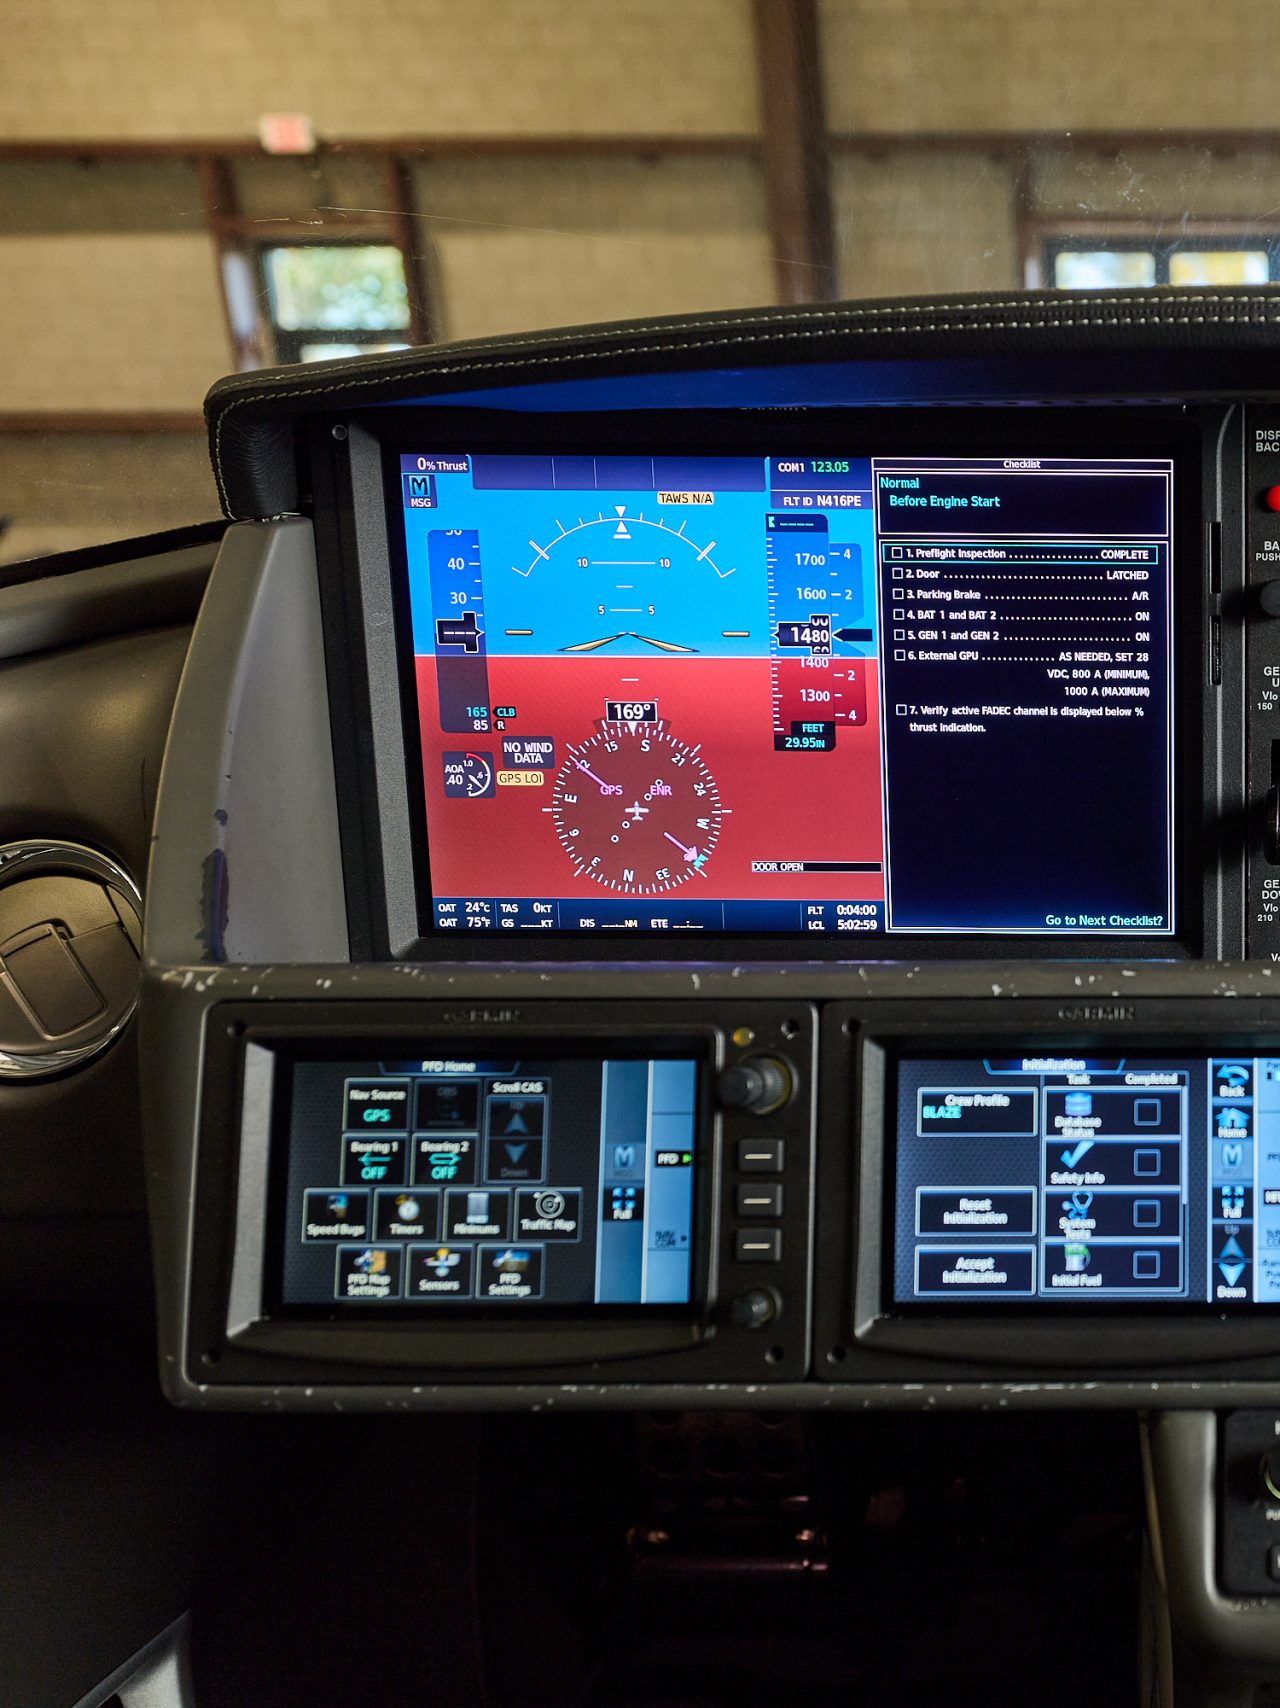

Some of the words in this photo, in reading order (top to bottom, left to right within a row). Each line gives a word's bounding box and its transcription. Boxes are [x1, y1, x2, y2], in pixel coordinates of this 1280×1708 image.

[778, 463, 805, 472] COM1
[811, 462, 849, 473] 123.05
[1004, 460, 1040, 468] Checklist
[880, 478, 919, 488] Normal
[411, 498, 431, 507] MSG
[660, 493, 688, 503] TAWS
[692, 493, 712, 503] N/A
[783, 497, 800, 506] FLT
[802, 497, 812, 506] ID
[817, 495, 861, 506] N416PE
[890, 496, 927, 506] Before
[930, 496, 968, 508] Engine
[971, 496, 1000, 507] Start
[795, 553, 825, 565] 1700
[1101, 551, 1148, 559] COMPLETE
[1256, 553, 1280, 561] PUSH
[1107, 571, 1148, 580] LATCHED
[796, 588, 826, 599] 1600
[1059, 653, 1072, 661] AS
[1074, 653, 1112, 662] NEEDED,
[1115, 653, 1134, 661] SET
[1137, 653, 1148, 661] 28
[800, 689, 830, 701] 1300
[466, 707, 487, 717] 165
[497, 708, 515, 717] CLB
[921, 706, 948, 716] Verify
[952, 706, 979, 715] active
[982, 706, 1010, 715] FADEC
[1014, 706, 1048, 715] channel
[1051, 707, 1058, 715] is
[1061, 707, 1102, 717] displayed
[1106, 707, 1132, 716] below
[1135, 708, 1144, 716] %
[803, 724, 824, 732] FEET
[910, 723, 937, 731] thrust
[940, 724, 986, 732] indication.
[503, 743, 521, 752] NO
[524, 743, 552, 752] WIND
[514, 754, 543, 764] DATA
[445, 765, 464, 774] AOA
[500, 774, 523, 783] GPS
[525, 774, 542, 783] LOI
[752, 863, 777, 871] DOOR
[780, 863, 803, 871] OPEN
[837, 905, 876, 915] 0:04:00
[808, 921, 824, 930] LCL
[838, 920, 877, 930] 5:02:59
[1046, 916, 1061, 925] Go
[1065, 916, 1076, 925] to
[1079, 916, 1106, 926] Next
[1110, 916, 1162, 926] Checklist?
[422, 1062, 441, 1072] PFD
[445, 1062, 476, 1072] Home
[1022, 1060, 1086, 1070] Initialization
[1067, 1074, 1090, 1084] Task
[1126, 1074, 1178, 1086] Completed
[350, 1090, 368, 1100] Nav
[371, 1090, 406, 1100] Source
[945, 1096, 971, 1106] Crew
[974, 1095, 1010, 1106] Profile
